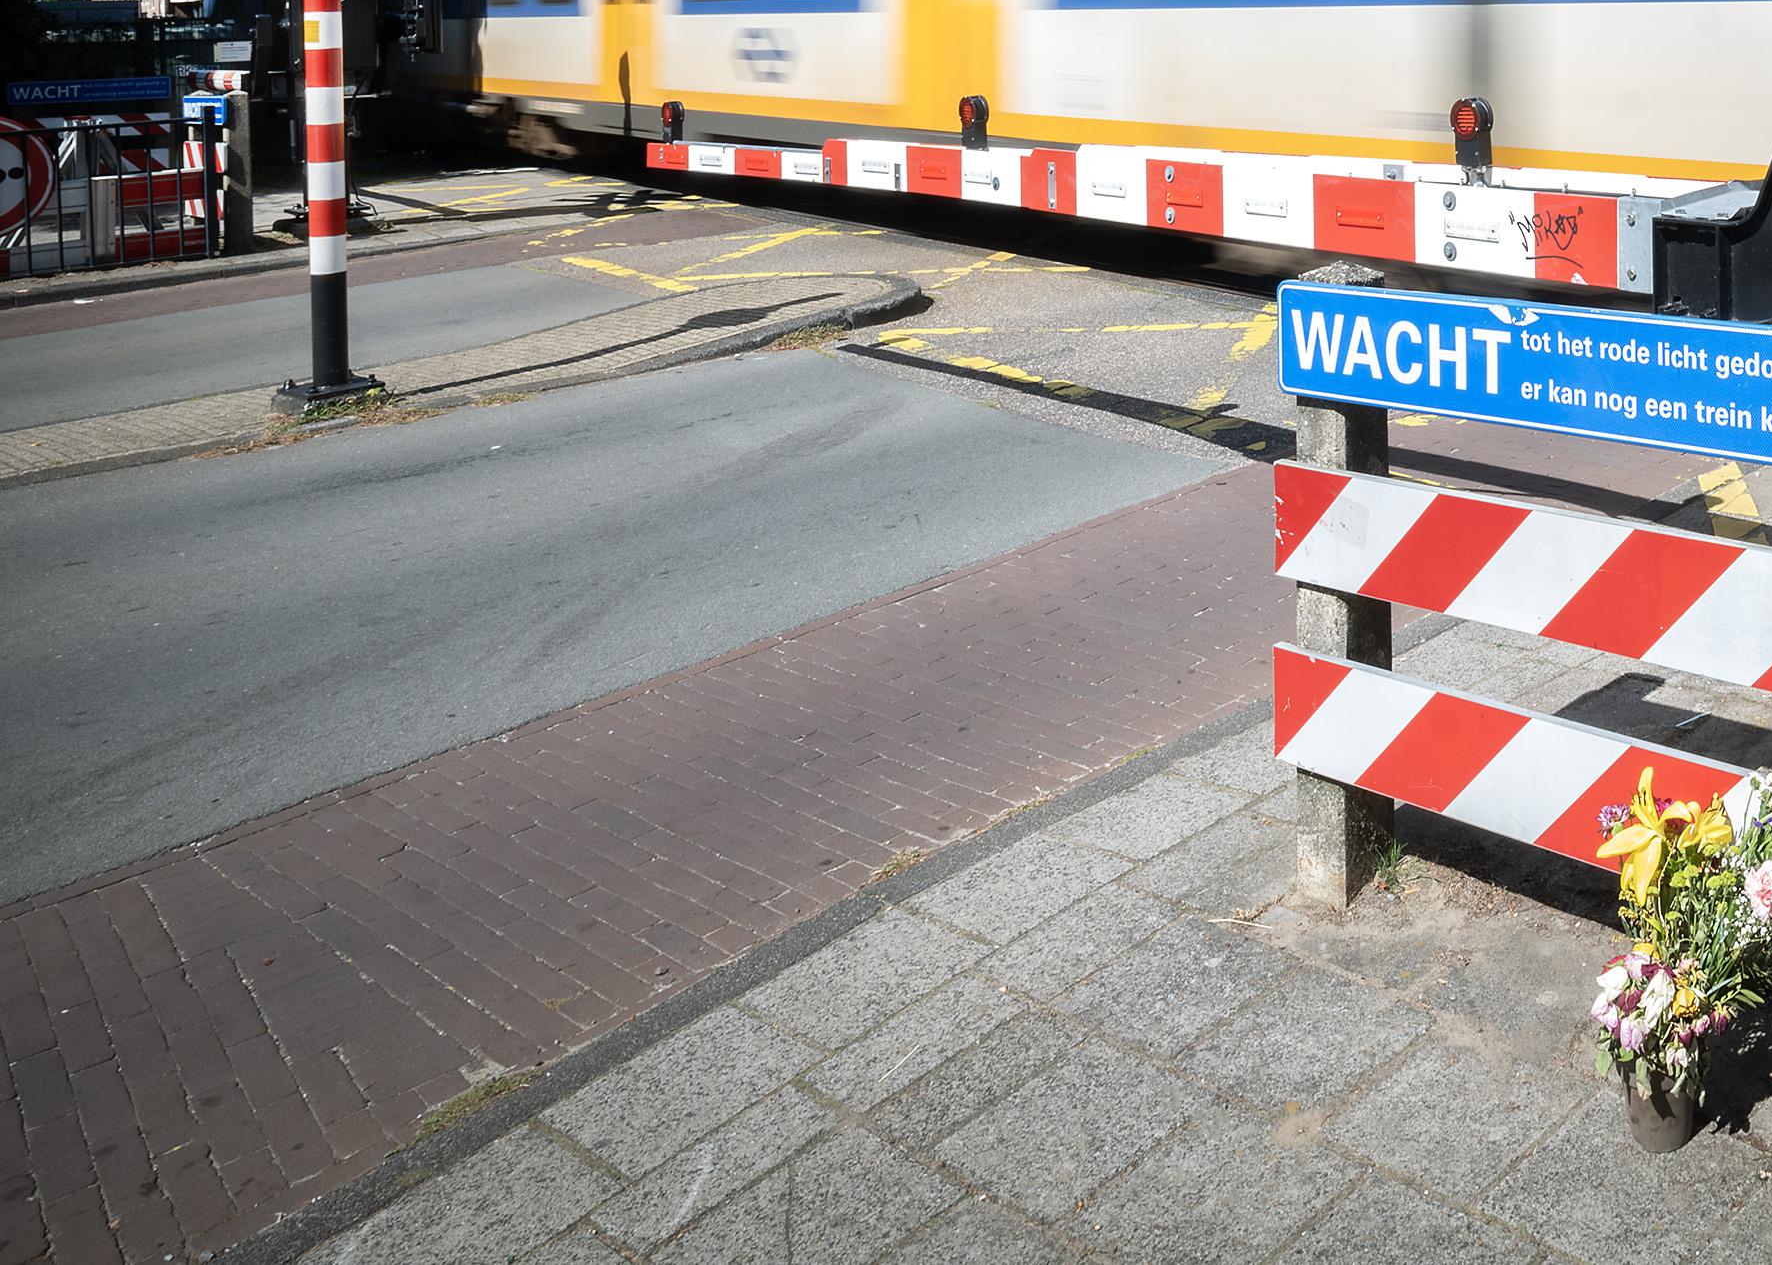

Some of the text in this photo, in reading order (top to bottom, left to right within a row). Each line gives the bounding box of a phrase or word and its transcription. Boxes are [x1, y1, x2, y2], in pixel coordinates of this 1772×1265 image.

[12, 84, 82, 100] WACHT
[1291, 309, 1512, 395] WACHT
[1521, 329, 1551, 353] tot
[1557, 331, 1593, 358] het
[1600, 338, 1650, 364] rode
[1657, 341, 1708, 371] licht
[1520, 381, 1542, 400] er
[1548, 379, 1587, 407] kan
[1594, 390, 1637, 419] nog
[1645, 397, 1688, 421] een
[1695, 400, 1751, 429] trein
